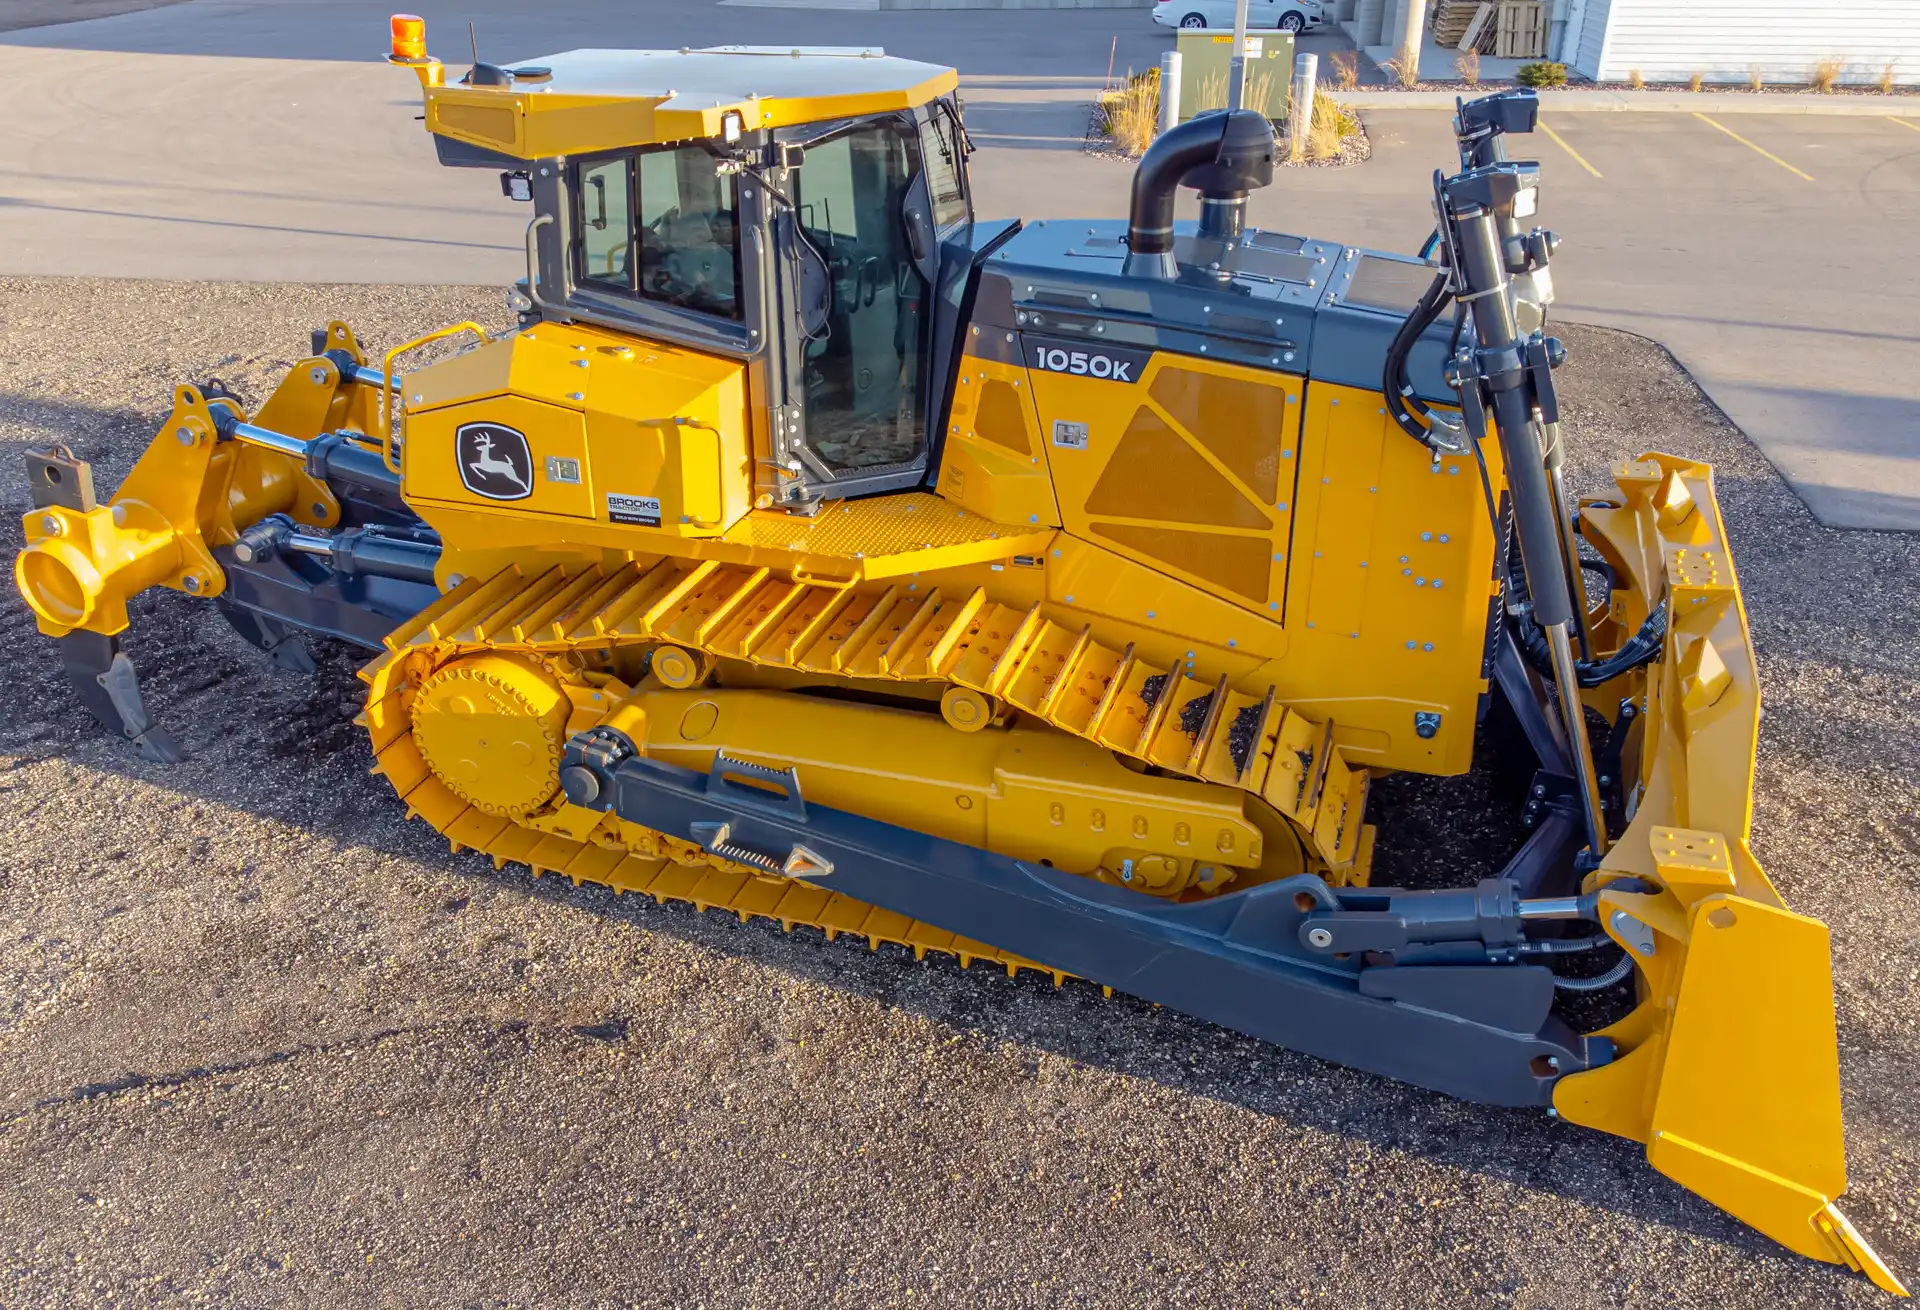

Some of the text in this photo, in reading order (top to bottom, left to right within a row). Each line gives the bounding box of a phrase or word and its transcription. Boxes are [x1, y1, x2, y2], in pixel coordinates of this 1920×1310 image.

[1037, 347, 1131, 381] 1050K
[608, 497, 659, 510] BROOKS
[609, 504, 641, 512] TRACTOR
